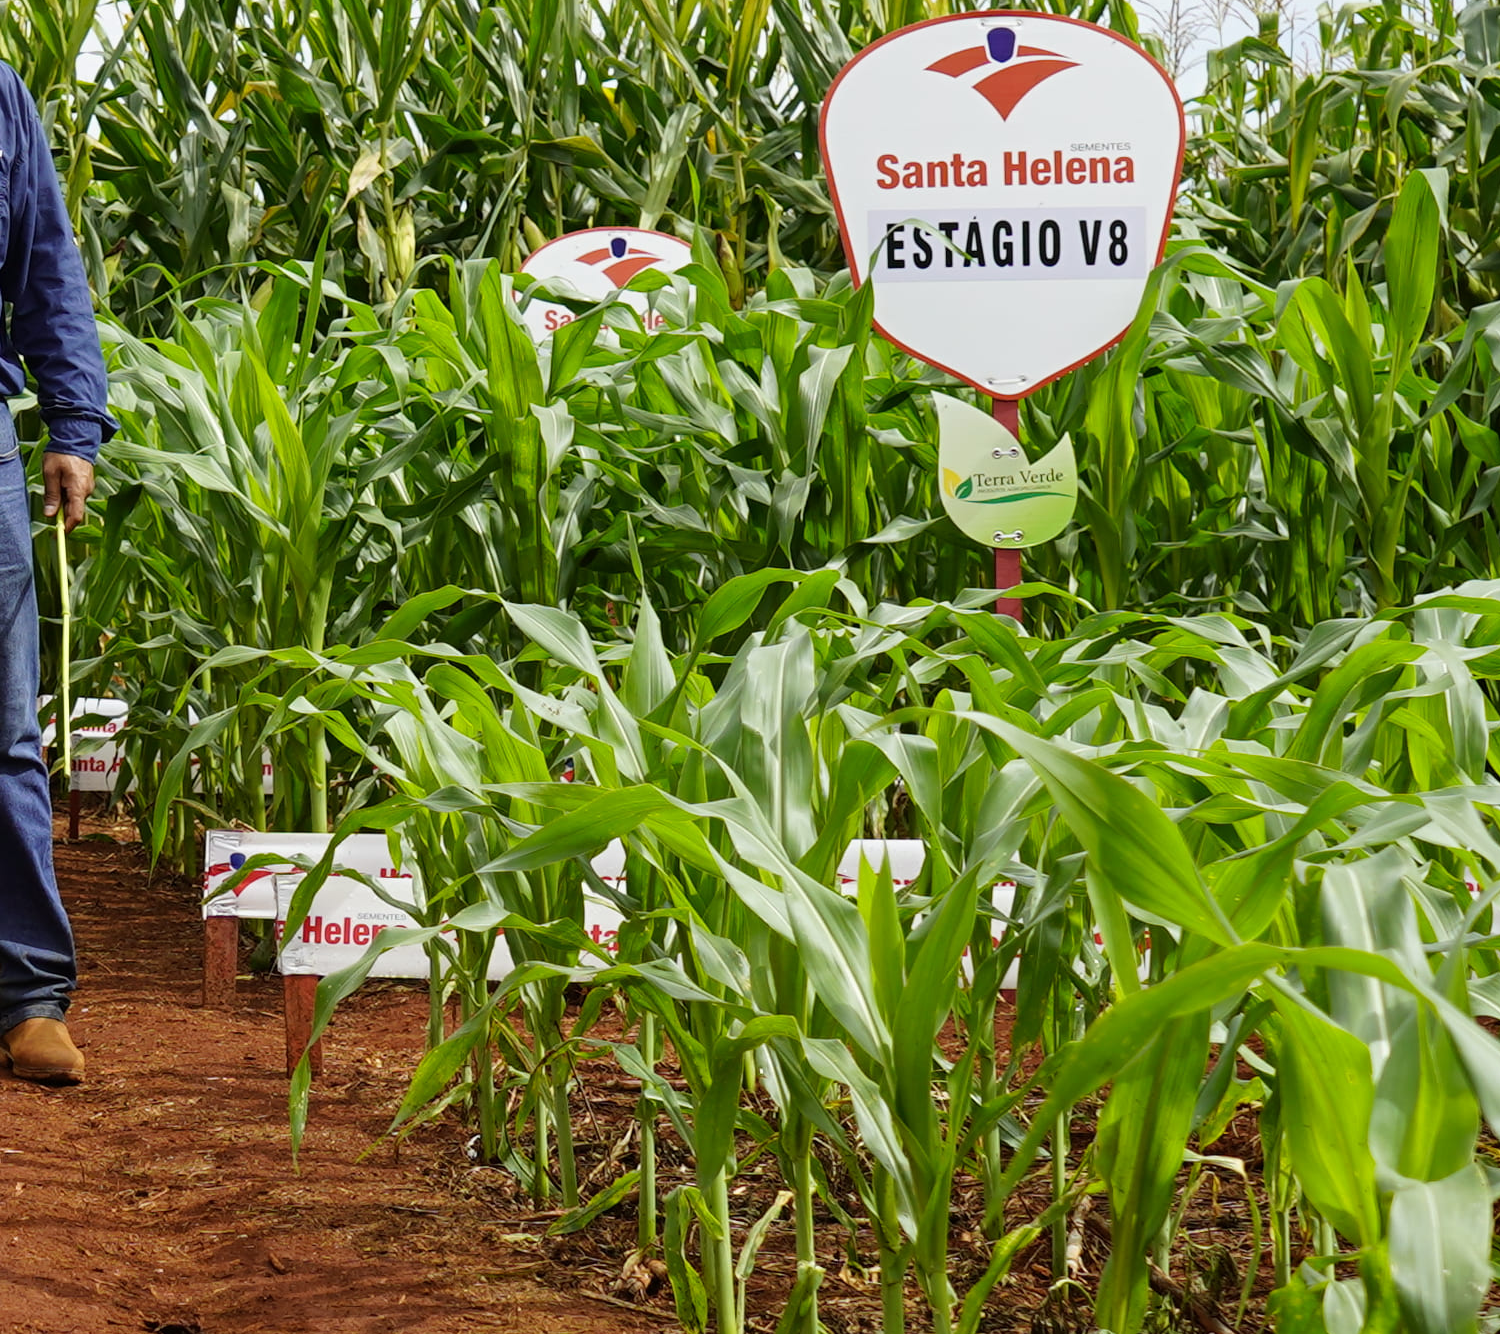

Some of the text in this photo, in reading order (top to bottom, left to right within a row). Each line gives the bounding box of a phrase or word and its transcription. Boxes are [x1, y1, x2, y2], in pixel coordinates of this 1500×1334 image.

[1070, 142, 1131, 152] SEMENTES
[876, 150, 1134, 189] Santa Helena
[886, 216, 1128, 269] ESTÁGIO V8
[973, 468, 1063, 487] Terra Verde
[357, 912, 407, 921] SEMENTES
